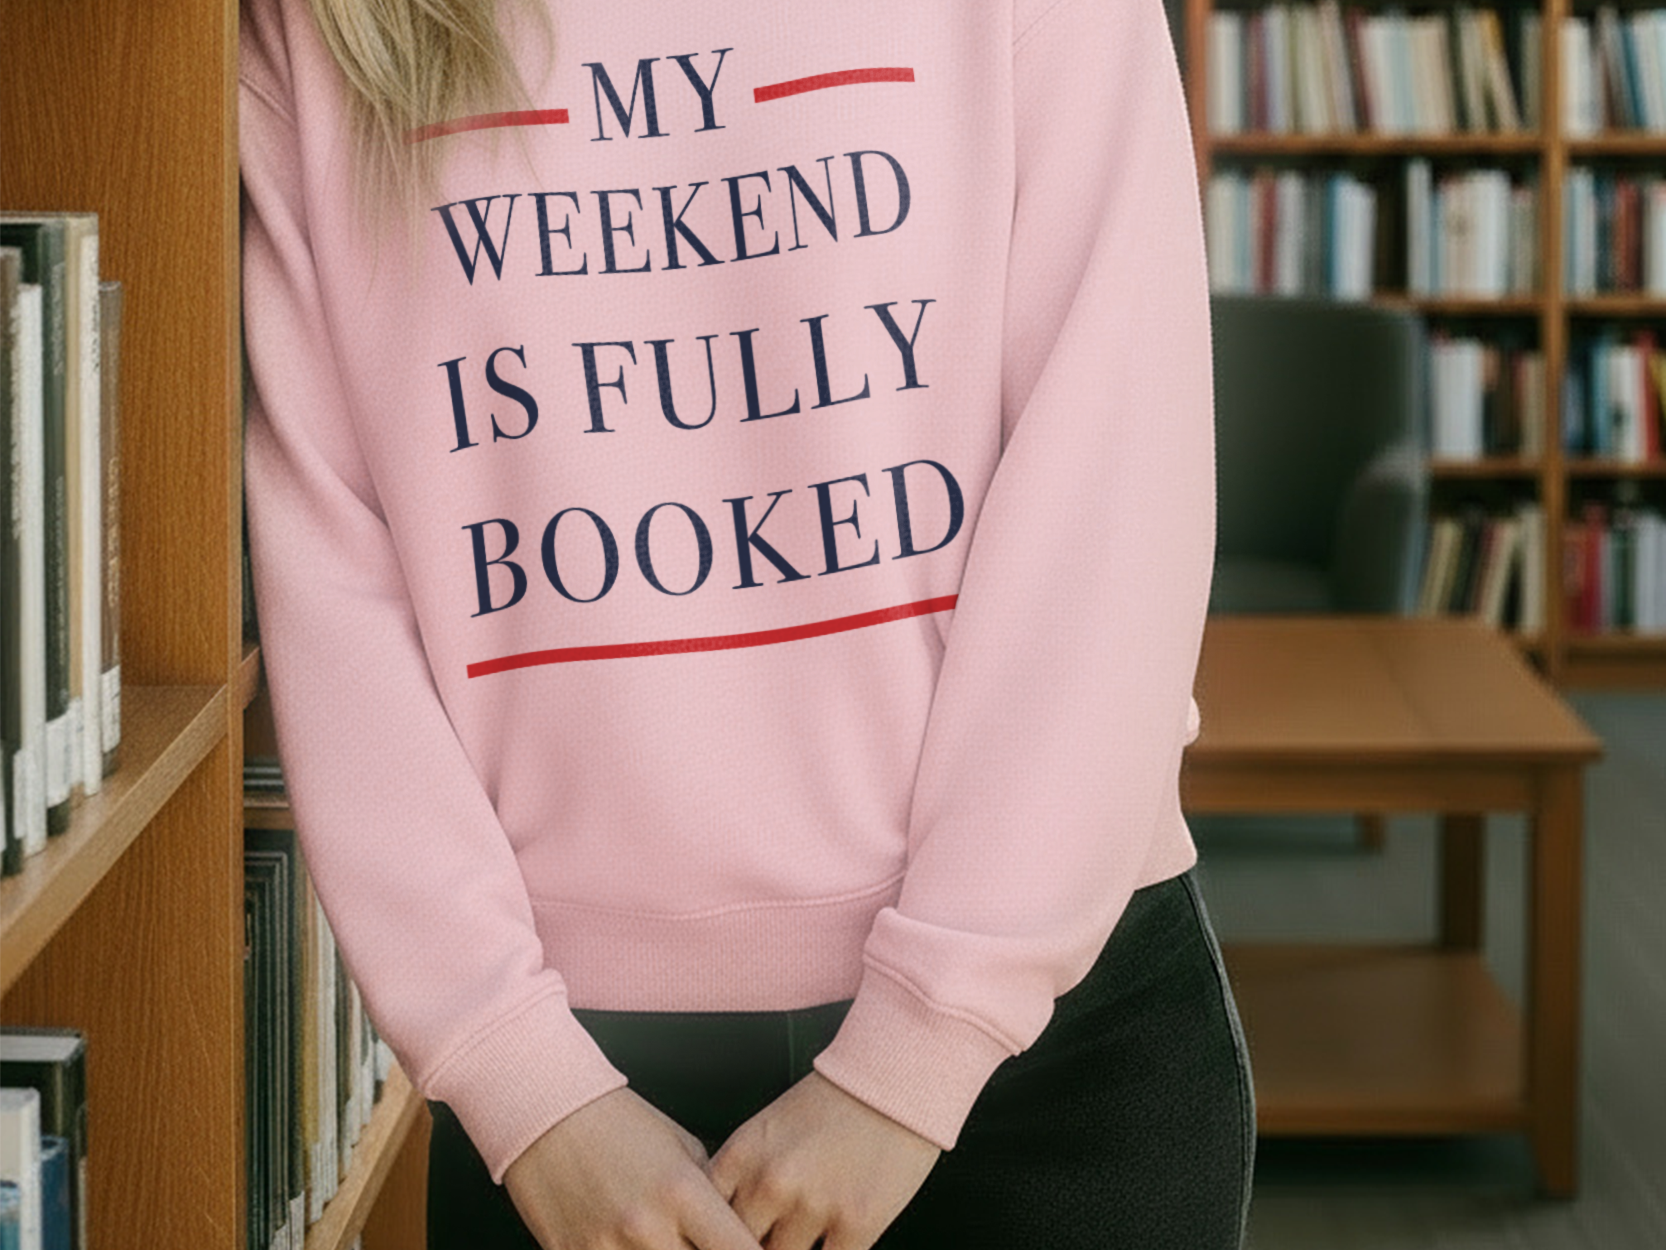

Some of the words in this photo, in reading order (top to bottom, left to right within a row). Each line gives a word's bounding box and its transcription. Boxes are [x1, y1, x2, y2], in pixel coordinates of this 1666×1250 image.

[581, 48, 734, 142] MY
[431, 149, 912, 286] WEEKEND
[437, 345, 540, 454] IS
[571, 298, 937, 434] FULLY
[461, 458, 965, 618] BOOKED
